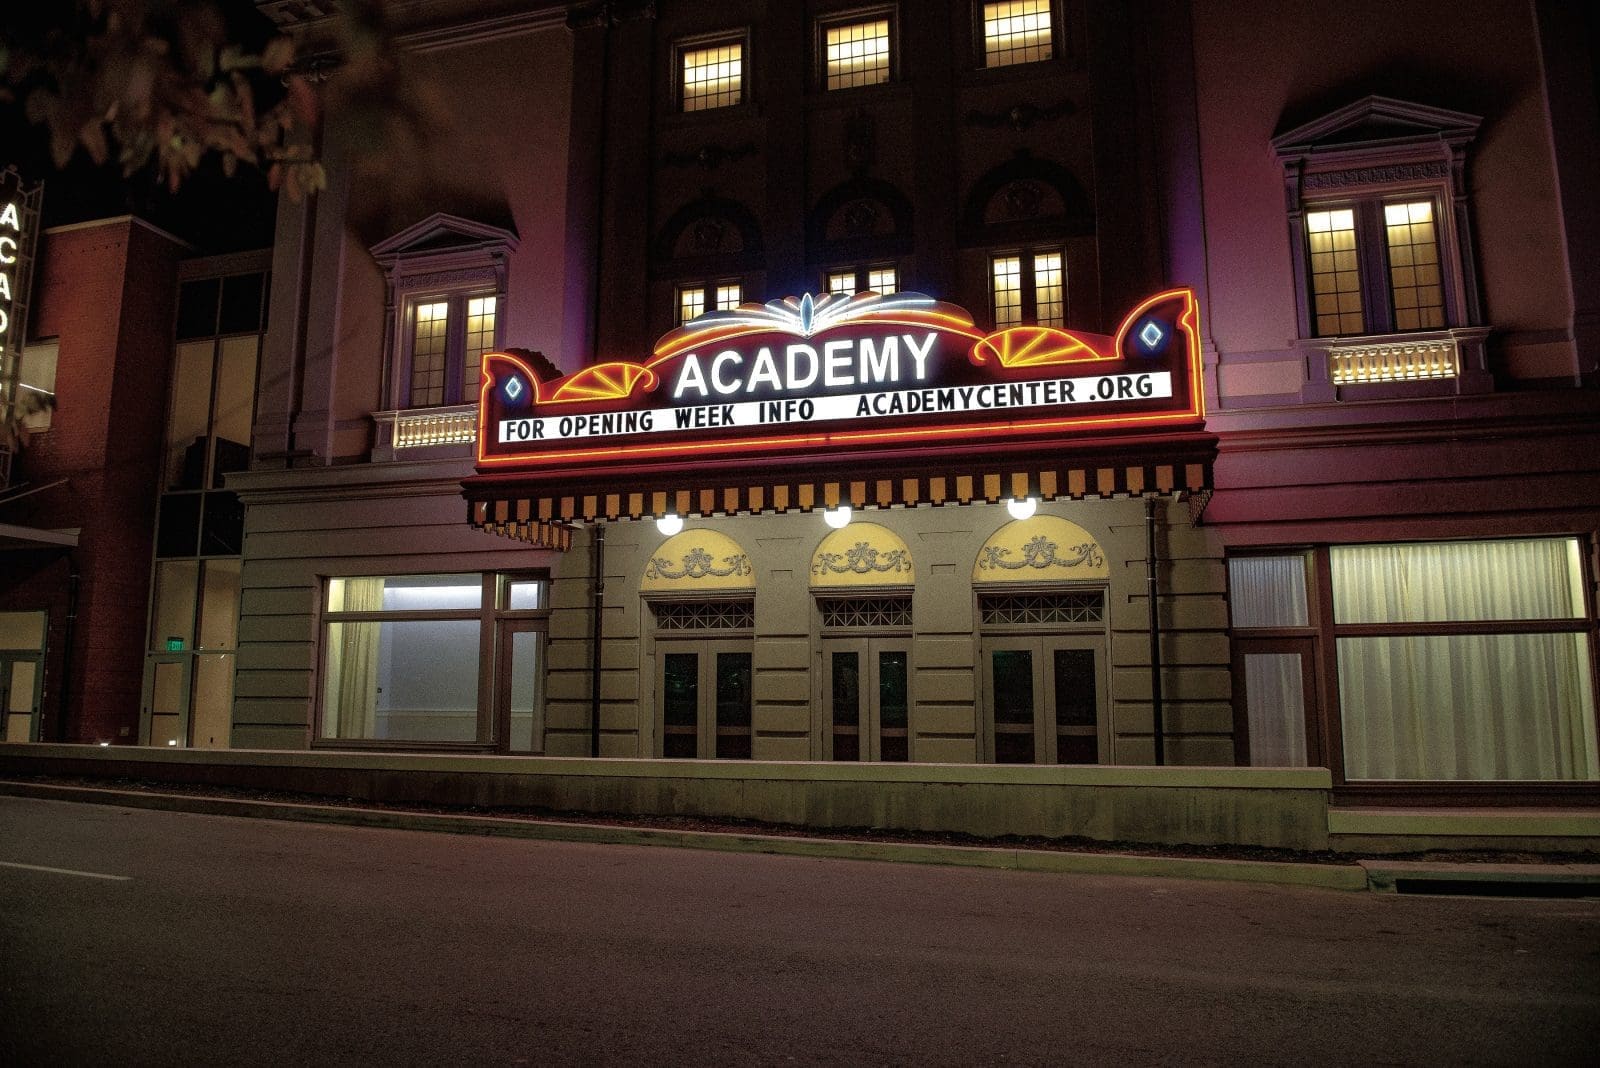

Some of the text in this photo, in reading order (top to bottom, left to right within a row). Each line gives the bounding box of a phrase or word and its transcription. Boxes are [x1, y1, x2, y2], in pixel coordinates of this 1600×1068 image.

[0, 202, 20, 392] ACAD
[673, 332, 938, 399] ACADEMY
[506, 374, 1152, 442] FOR OPENING WEEK INFO ACADEMYCENTER .ORG
